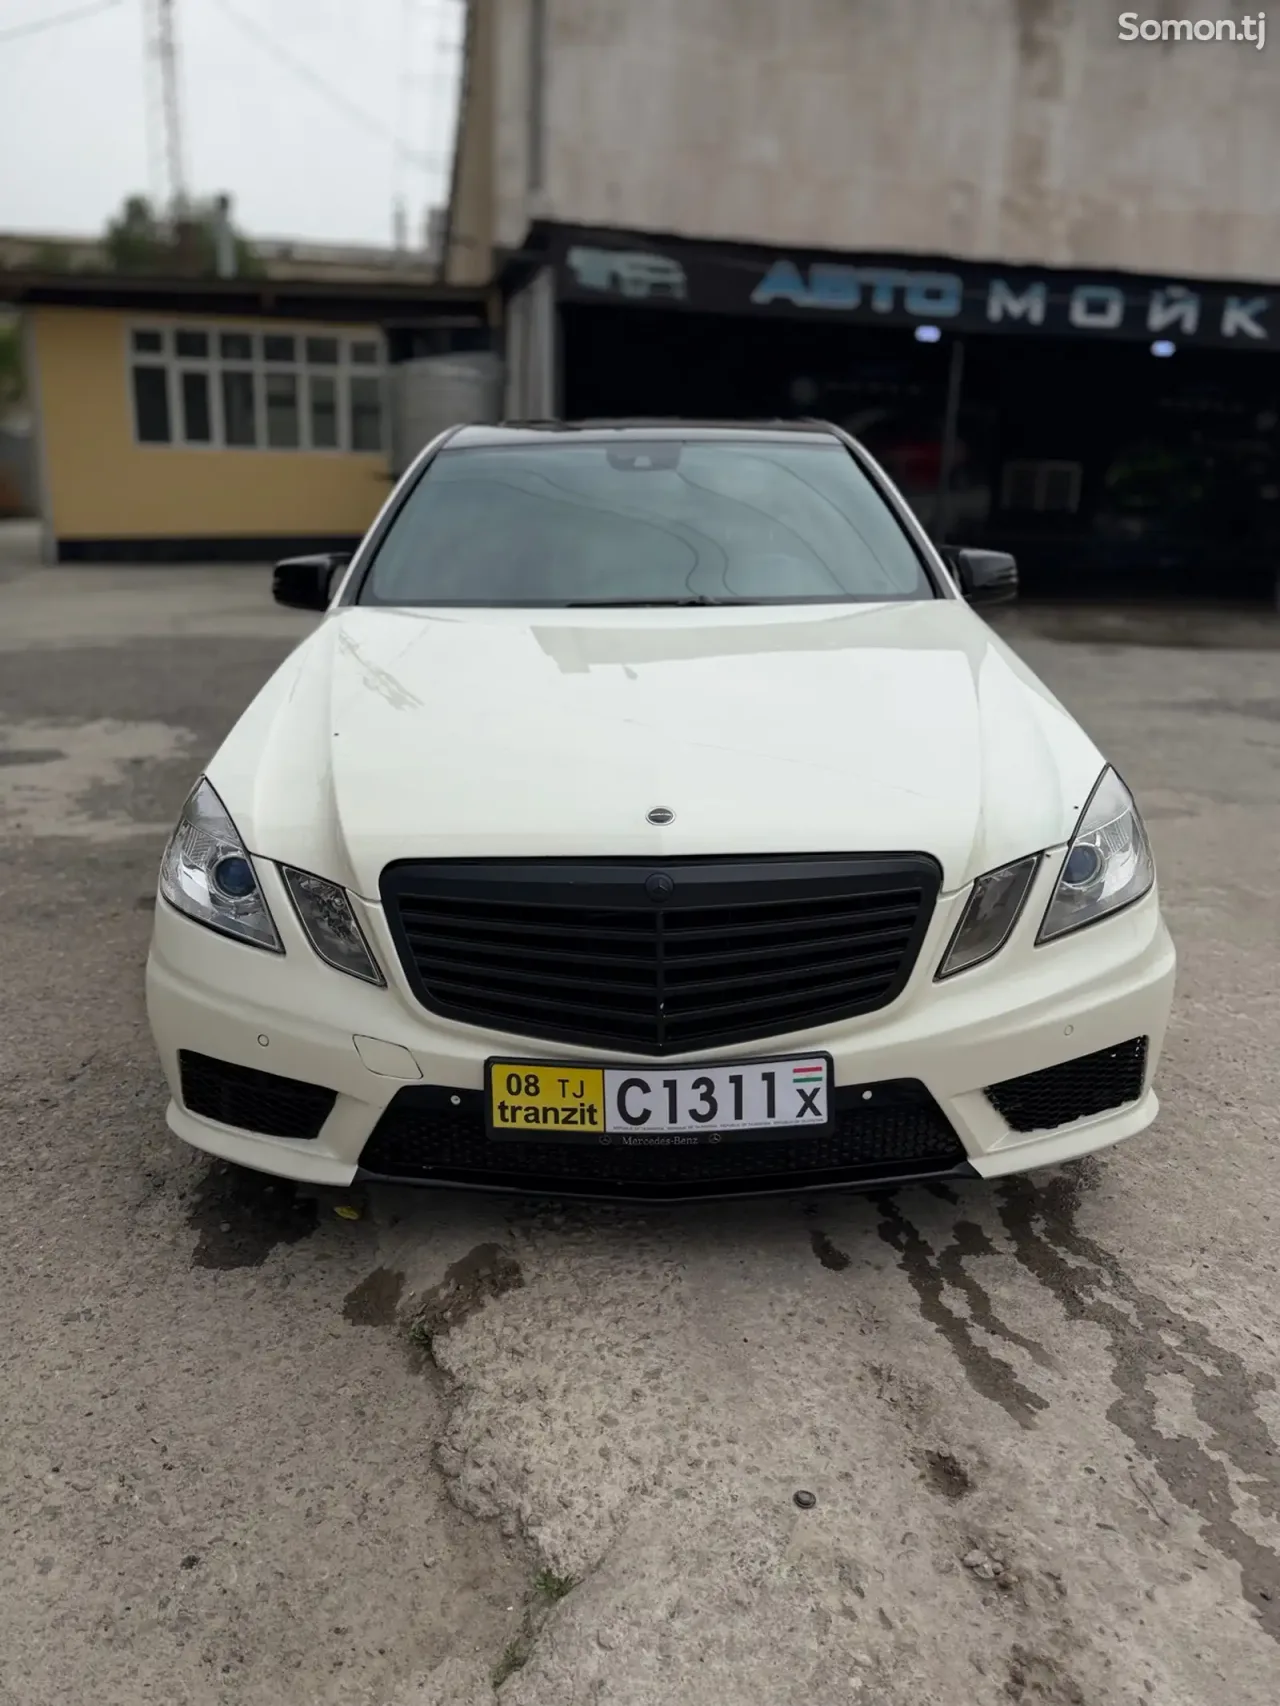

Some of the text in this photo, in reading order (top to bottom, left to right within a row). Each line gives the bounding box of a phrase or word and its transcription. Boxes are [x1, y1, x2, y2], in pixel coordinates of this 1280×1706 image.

[506, 1073, 585, 1099] 08 TJ
[617, 1072, 776, 1126] C1311
[498, 1101, 598, 1126] tranzit
[622, 1136, 698, 1146] Mercedes-Benz
